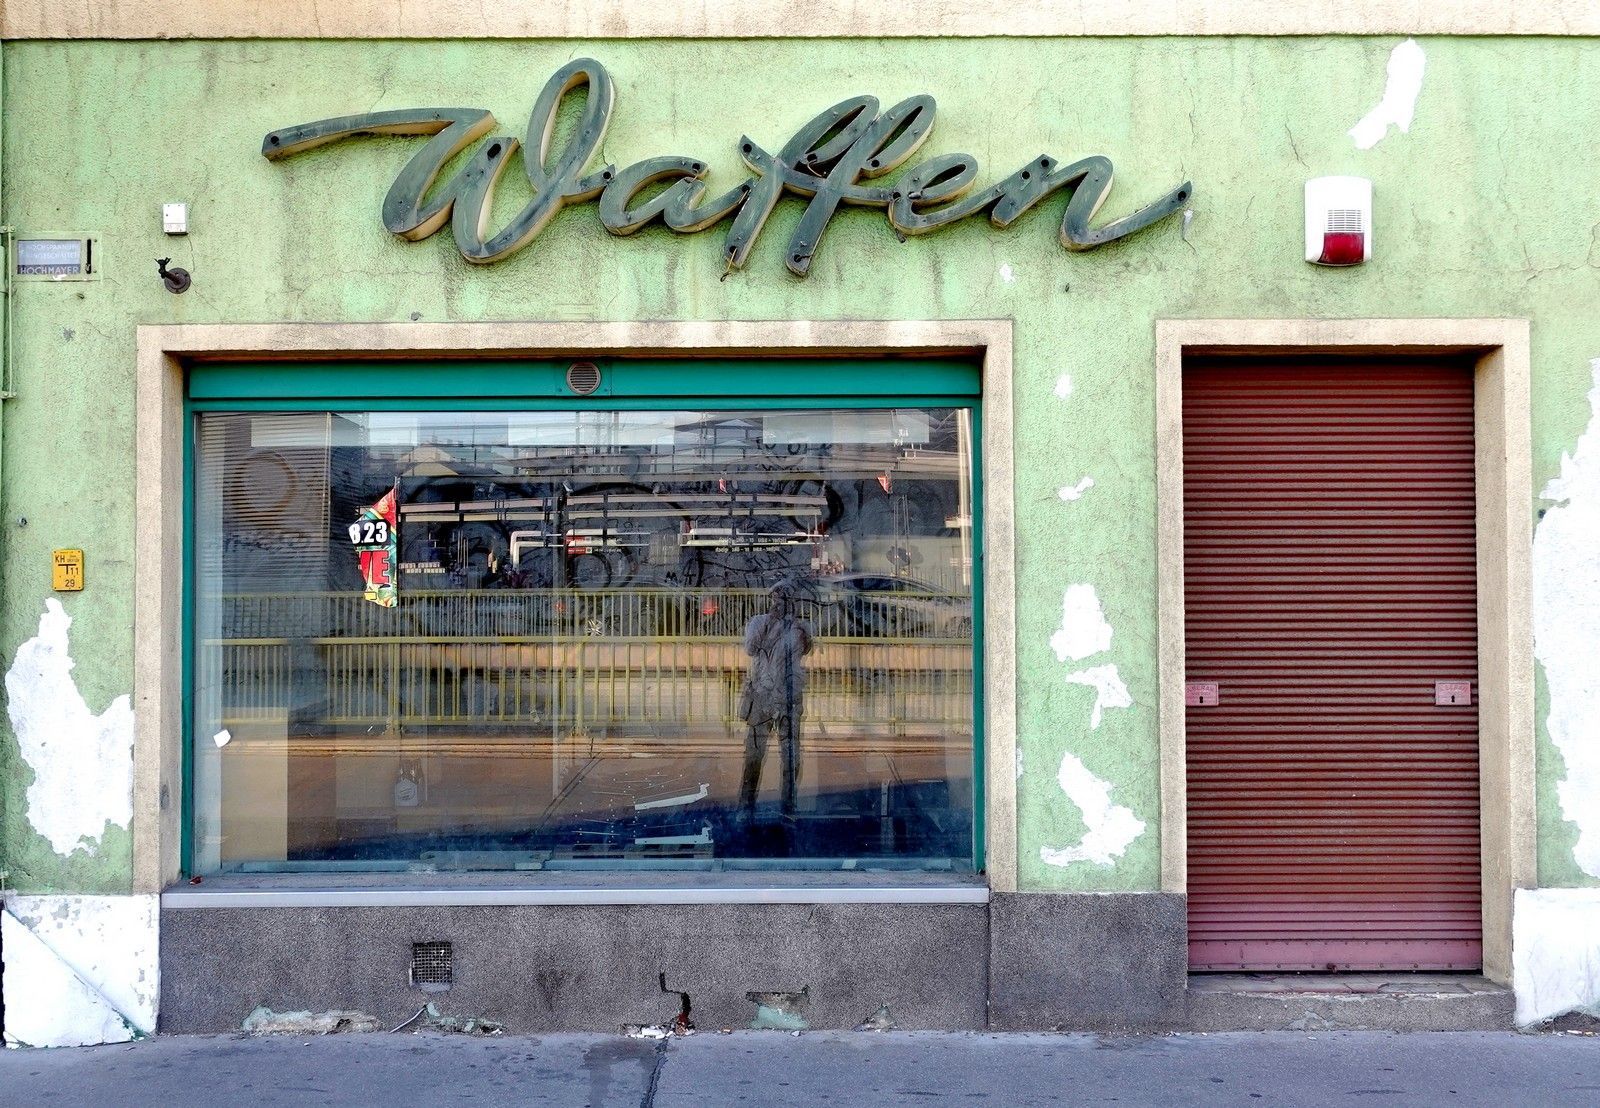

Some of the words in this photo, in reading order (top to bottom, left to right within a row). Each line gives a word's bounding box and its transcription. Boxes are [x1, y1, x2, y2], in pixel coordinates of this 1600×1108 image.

[262, 56, 1193, 279] Waffen
[20, 266, 79, 274] HOCHMAYER
[55, 555, 65, 563] KH
[65, 579, 75, 588] 29
